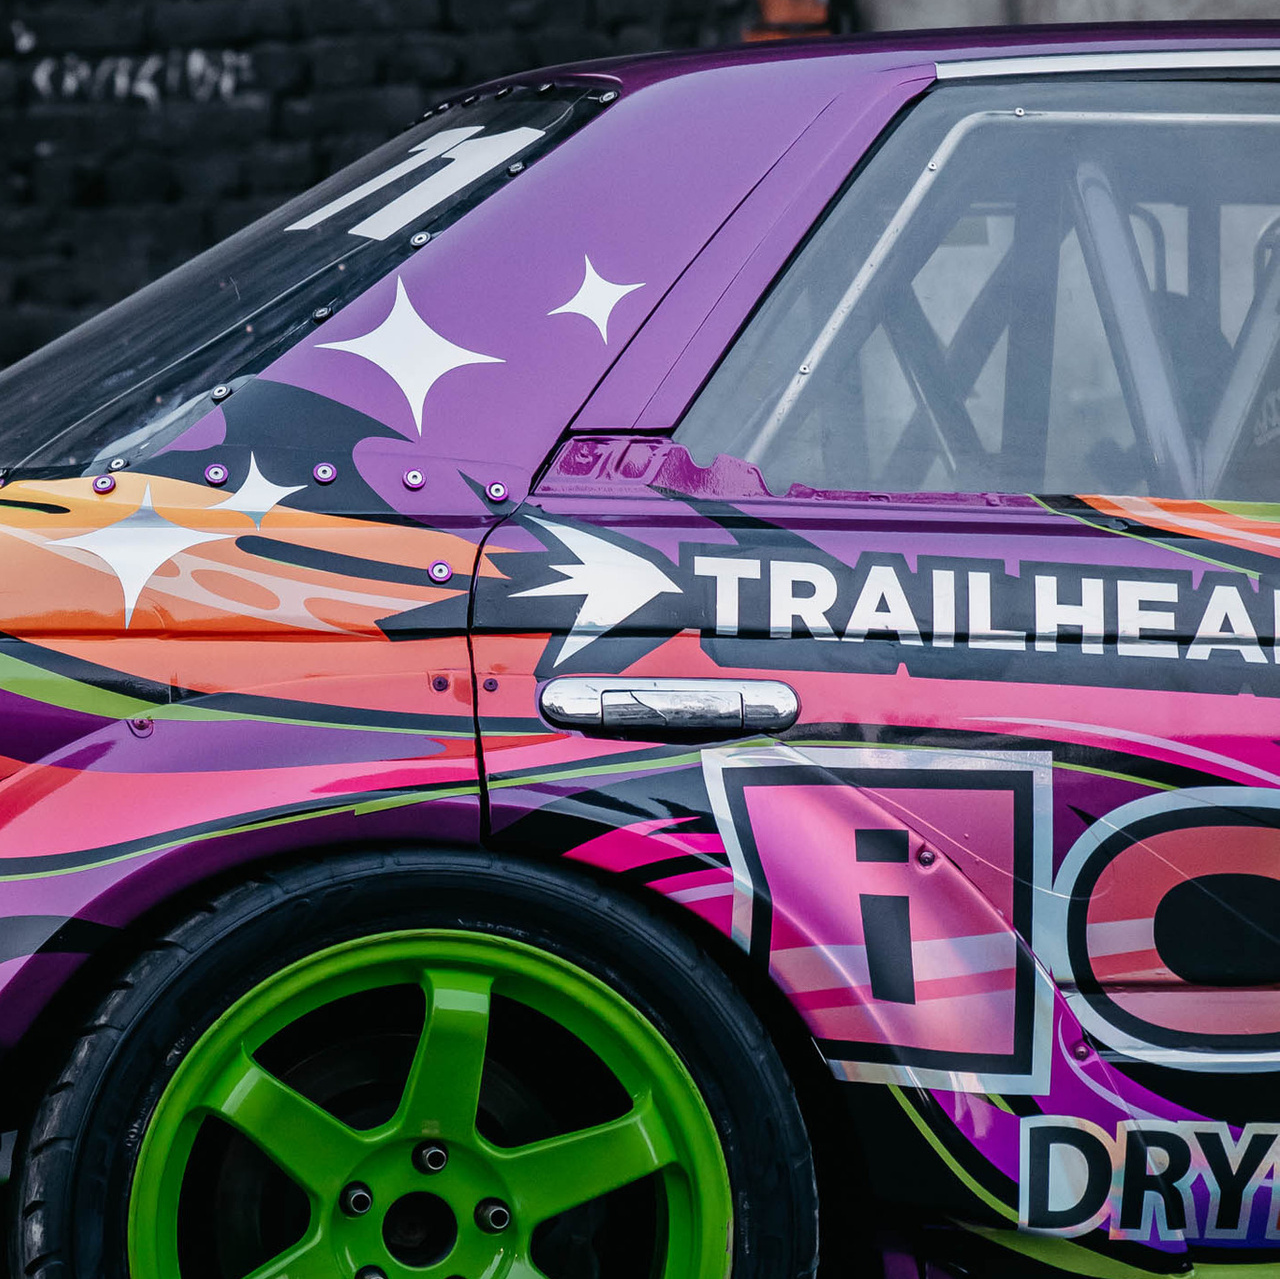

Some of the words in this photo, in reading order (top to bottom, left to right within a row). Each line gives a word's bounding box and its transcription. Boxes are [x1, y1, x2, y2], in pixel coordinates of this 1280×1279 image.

[283, 125, 546, 241] 11
[694, 556, 1280, 664] TRAILHEA
[1027, 1125, 1280, 1229] DRY
